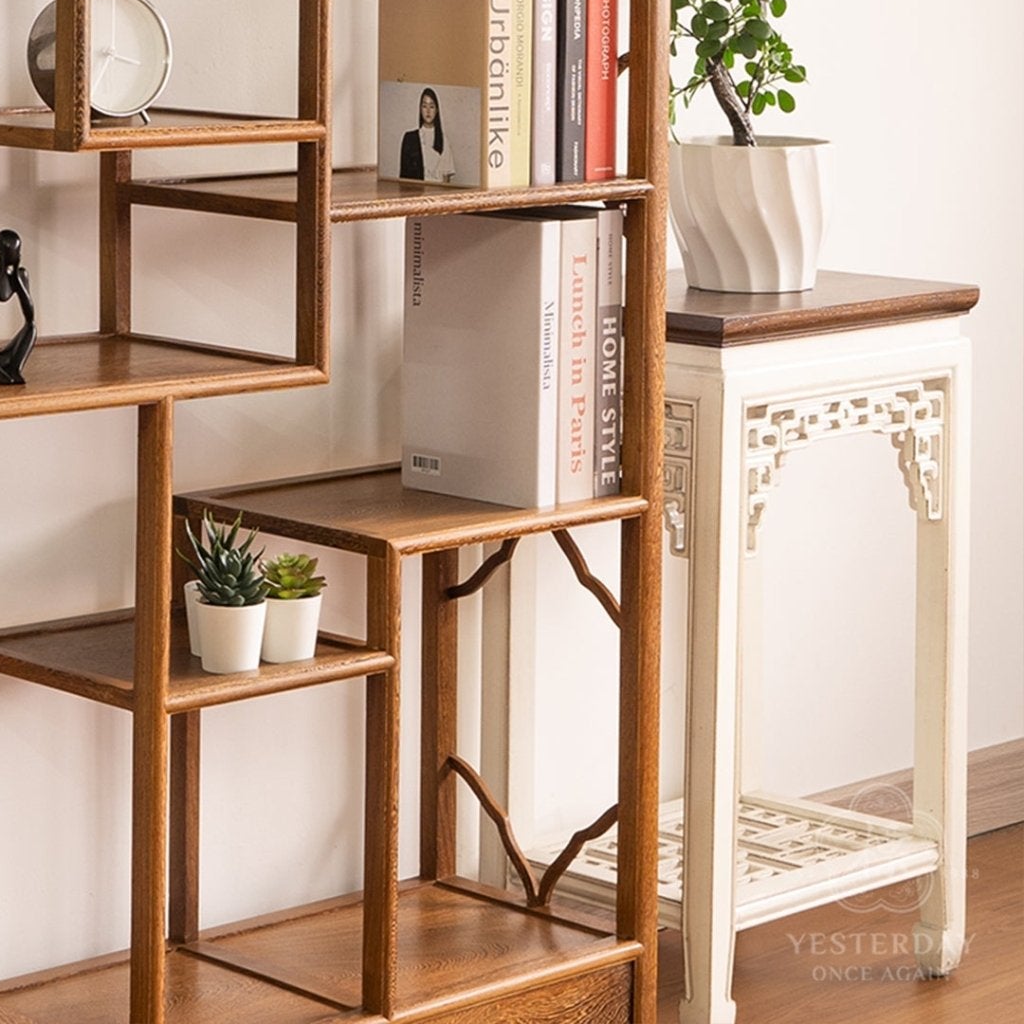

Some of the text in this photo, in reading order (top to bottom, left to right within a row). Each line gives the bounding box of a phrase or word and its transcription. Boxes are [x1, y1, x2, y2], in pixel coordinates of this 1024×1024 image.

[515, 34, 524, 88] MORANDI
[412, 222, 425, 307] minimalista
[543, 301, 555, 391] Minimalista
[570, 254, 588, 475] Lunch in Paris
[601, 317, 617, 486] HOME STYLE
